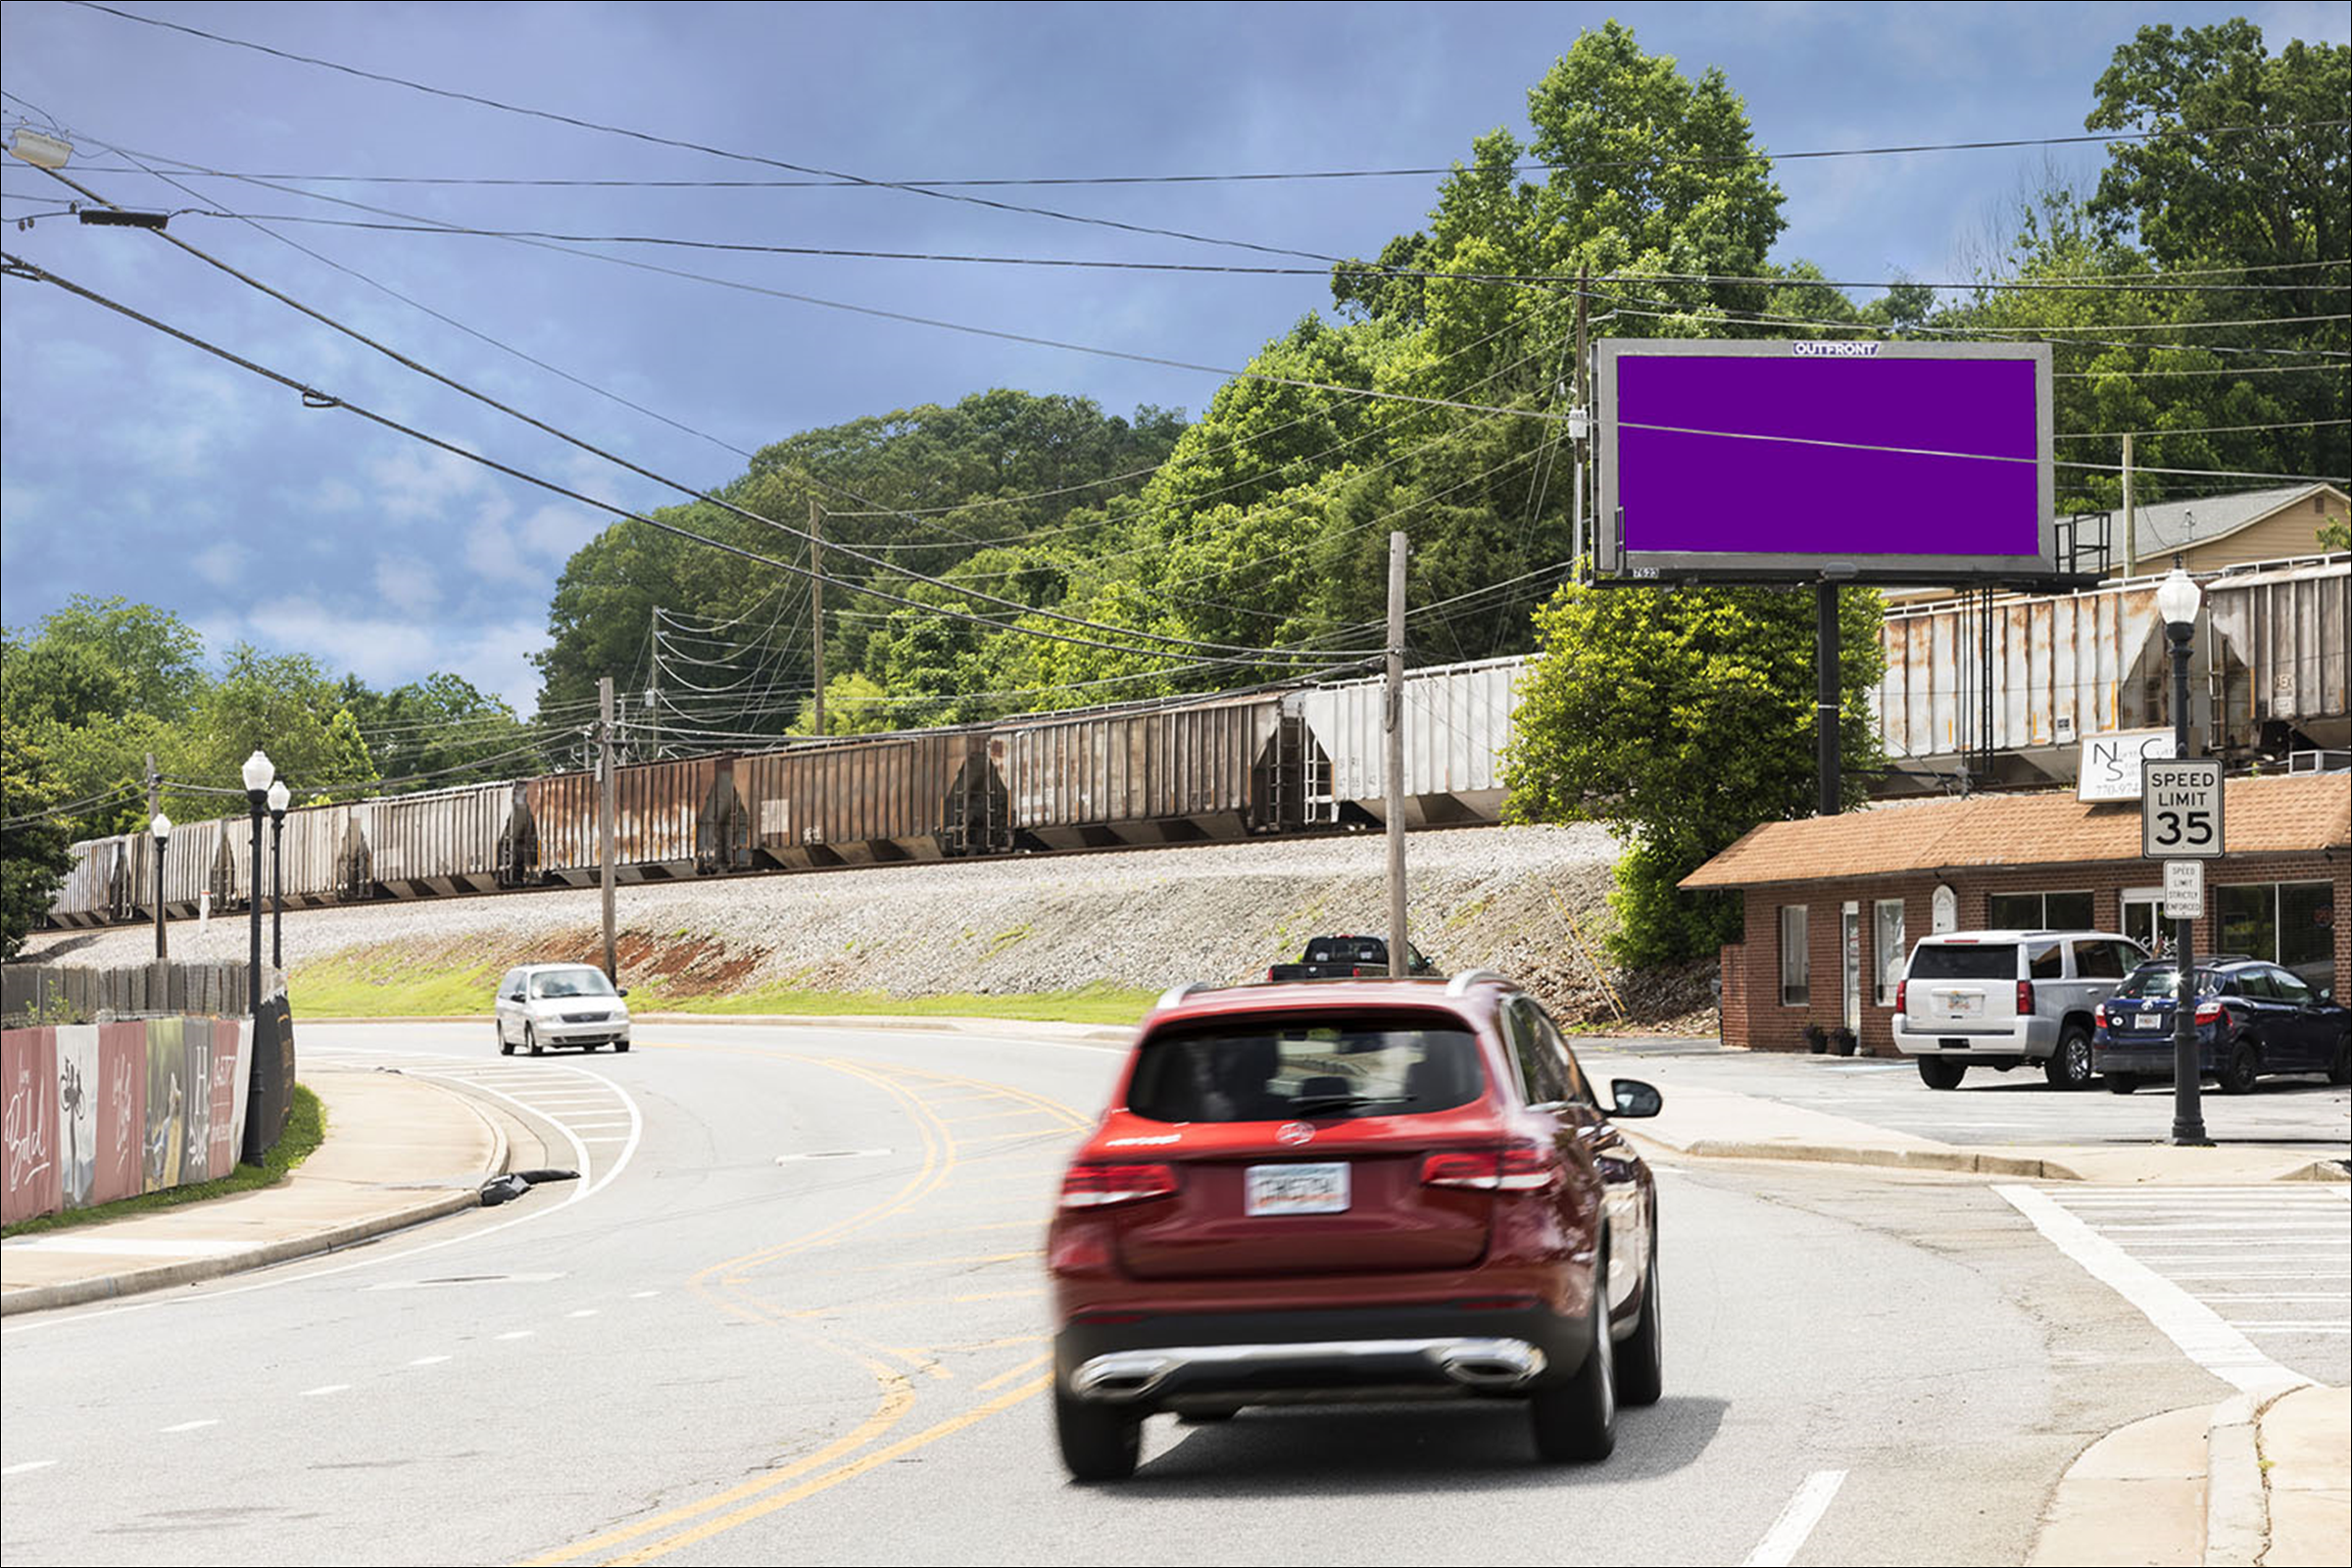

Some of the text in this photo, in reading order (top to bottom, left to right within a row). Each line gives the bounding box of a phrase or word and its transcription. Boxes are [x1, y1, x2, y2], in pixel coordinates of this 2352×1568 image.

[1795, 343, 1876, 356] OUTFRONT
[2151, 772, 2215, 788] SPEED
[2158, 792, 2207, 807] LIMIT
[2156, 810, 2213, 845] 35
[2172, 866, 2195, 875] SPEED
[2174, 878, 2193, 887] LIMIT
[2169, 891, 2198, 900] STRICTLY
[2166, 903, 2201, 911] ENFORCED
